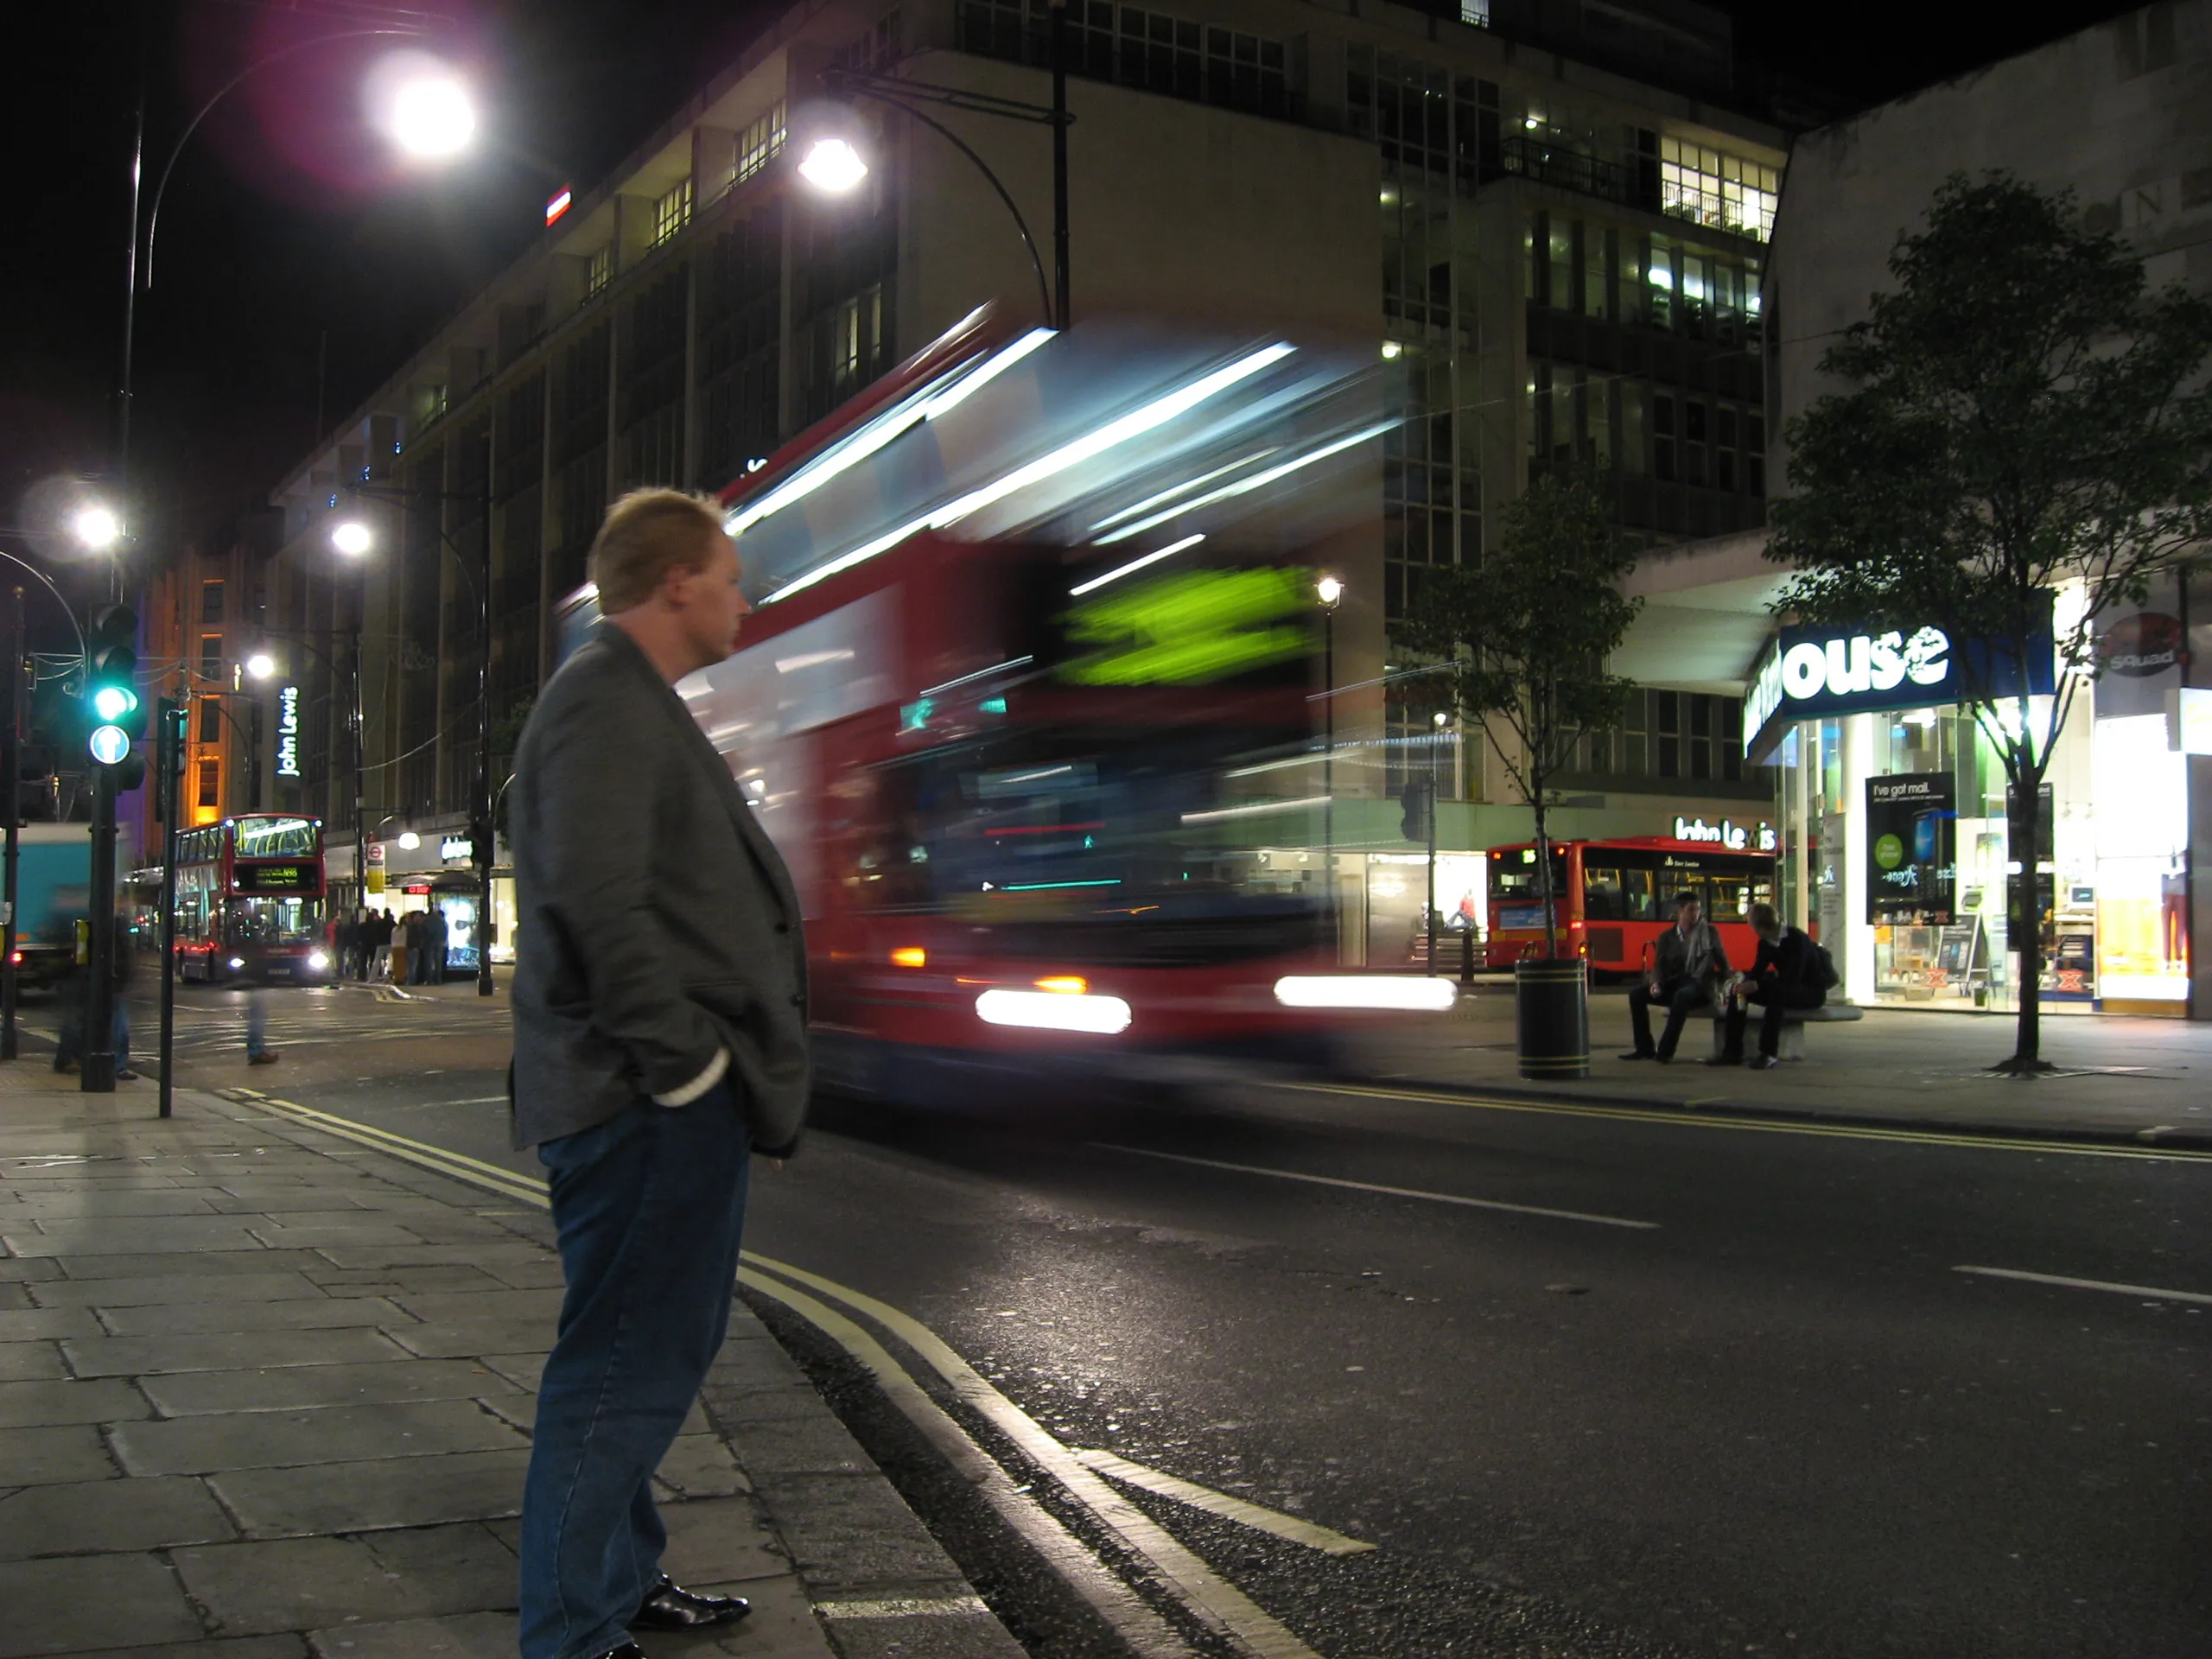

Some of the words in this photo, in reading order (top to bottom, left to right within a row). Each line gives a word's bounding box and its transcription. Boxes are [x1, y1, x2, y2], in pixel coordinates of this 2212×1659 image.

[278, 686, 299, 734] Lewis
[276, 735, 301, 777] John
[1891, 784, 1906, 798] got
[1723, 819, 1776, 850] Lewis
